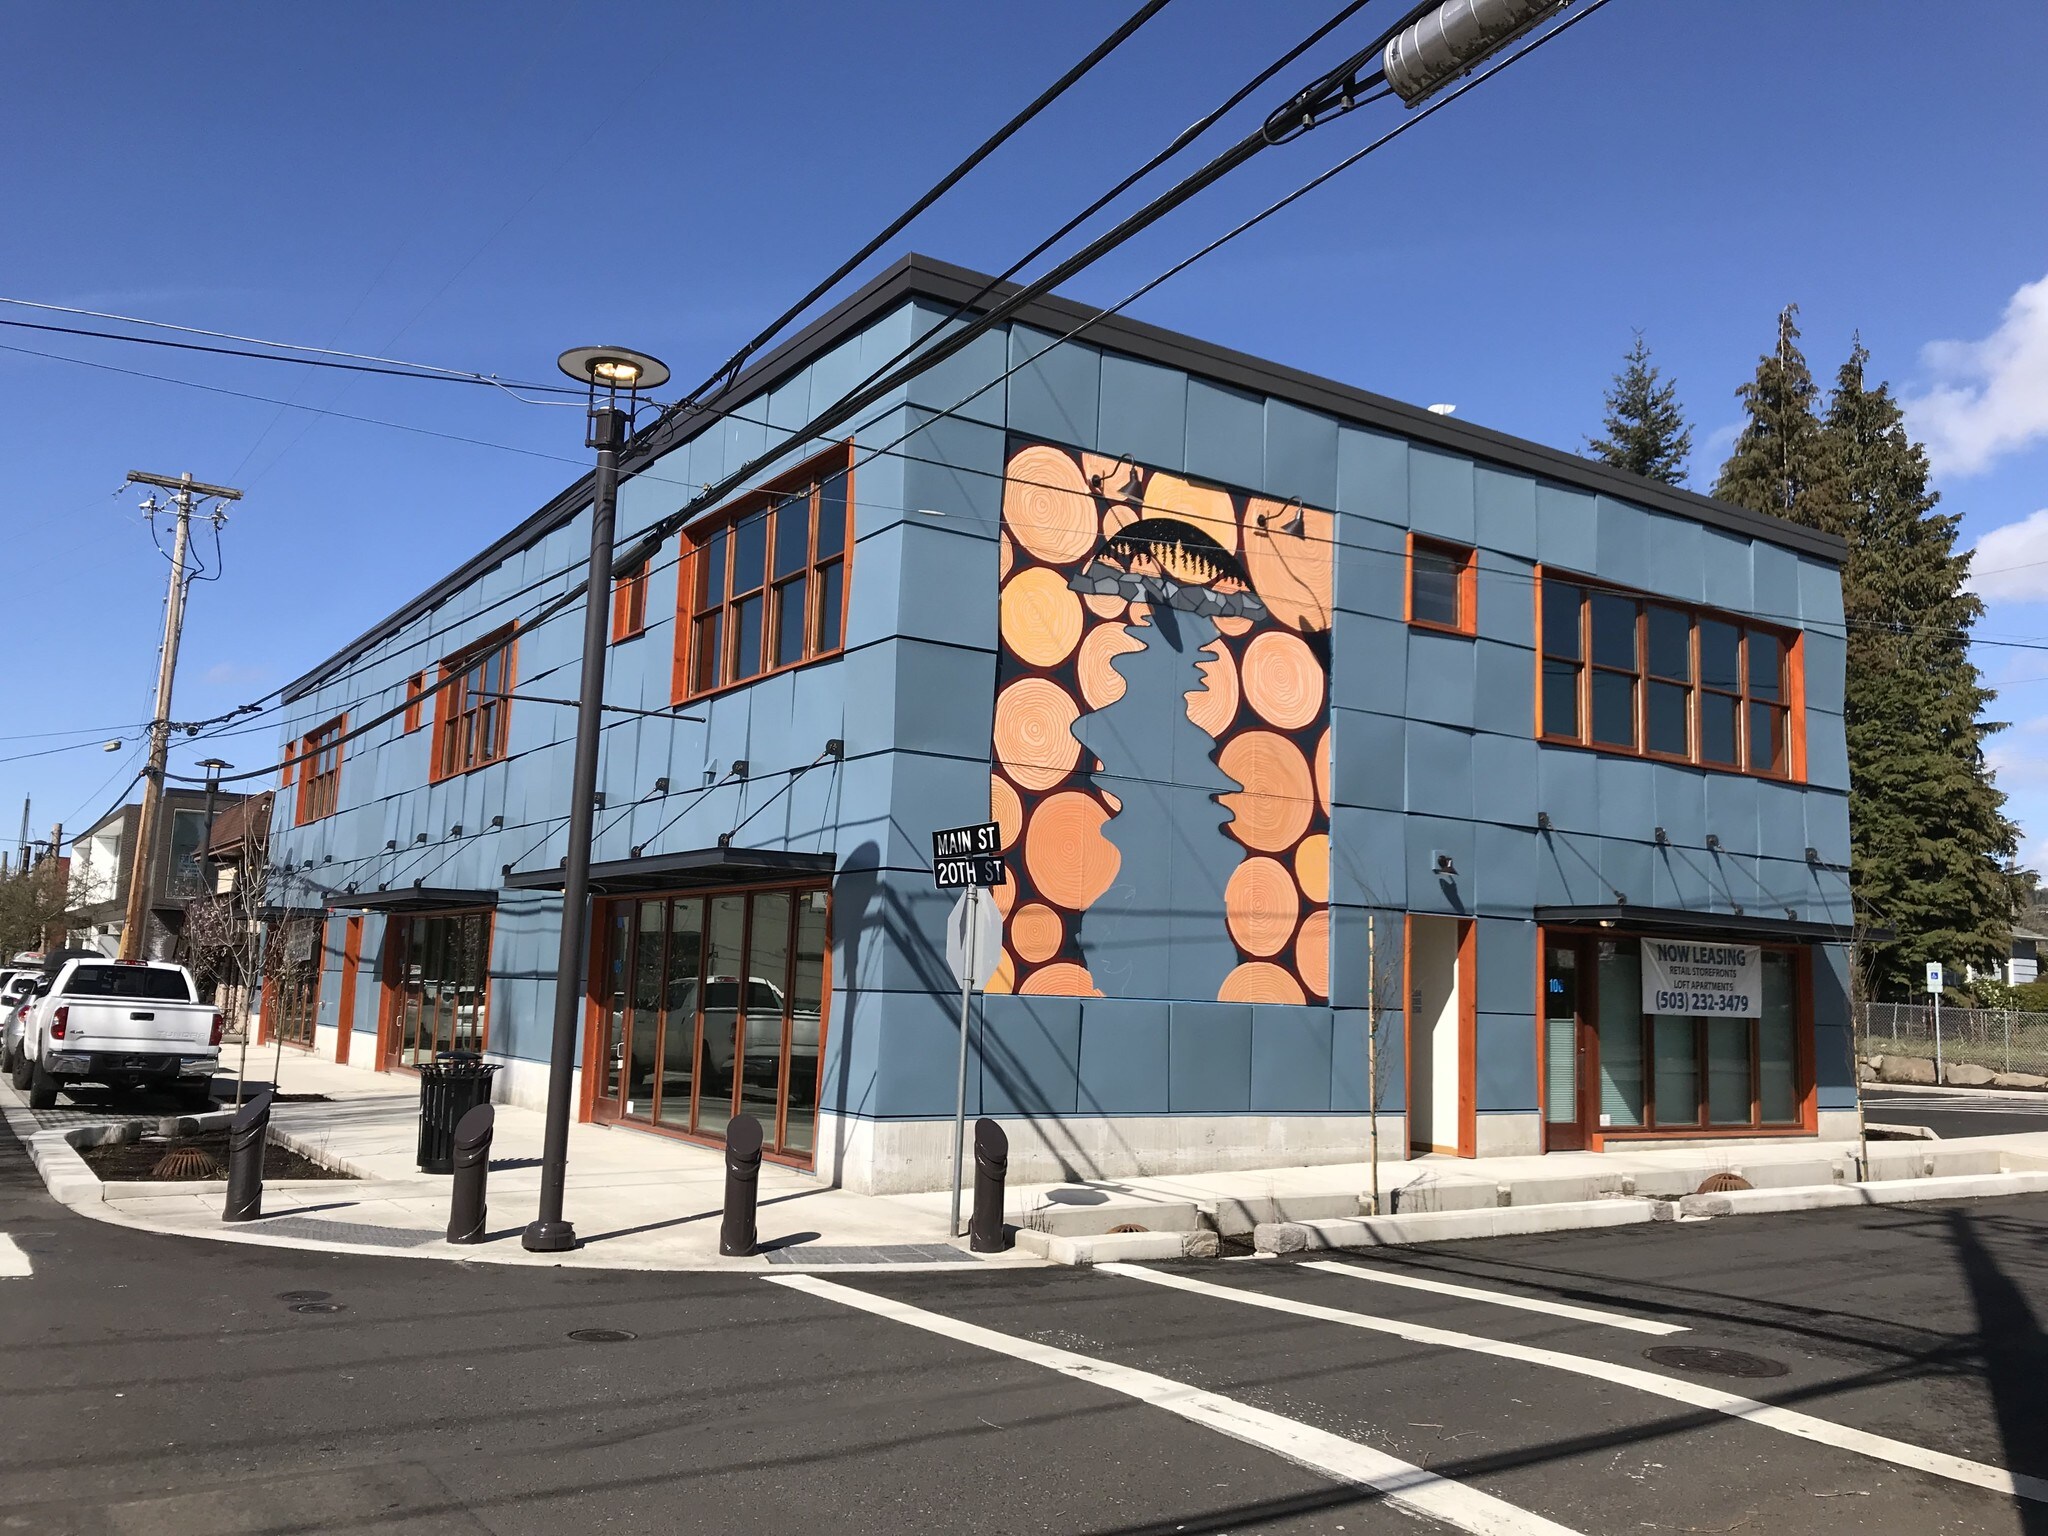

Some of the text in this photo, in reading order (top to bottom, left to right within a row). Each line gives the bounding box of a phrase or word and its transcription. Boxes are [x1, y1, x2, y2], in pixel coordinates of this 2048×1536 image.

[937, 826, 995, 856] MAIN ST
[937, 860, 1002, 885] 20TH ST
[1656, 943, 1746, 967] NOW LEASING
[1669, 966, 1737, 978] RETAIL STOREFRONTS
[1674, 980, 1734, 992] LOFT APARTMENTS
[1656, 990, 1749, 1012] (503) 232-3479
